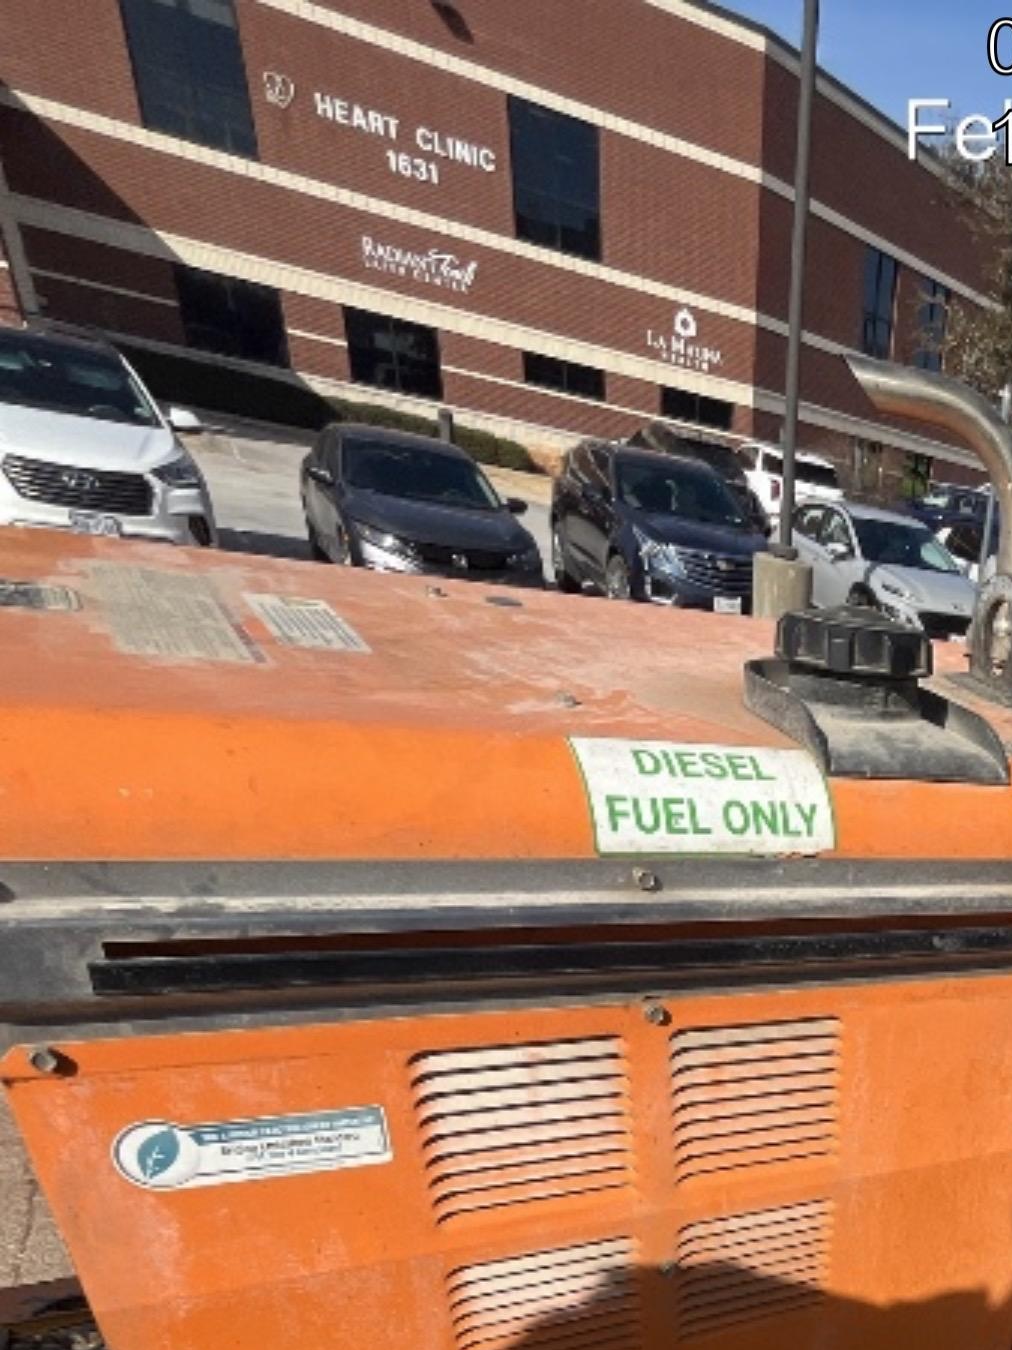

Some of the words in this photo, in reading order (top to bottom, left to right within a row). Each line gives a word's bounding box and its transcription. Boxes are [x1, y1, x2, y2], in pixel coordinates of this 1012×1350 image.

[313, 91, 400, 141] HEART
[415, 125, 497, 173] CLINIC
[385, 149, 440, 185] 1631
[631, 748, 777, 781] DIESEL
[605, 794, 712, 835] FUEL
[723, 799, 818, 838] ONLY
